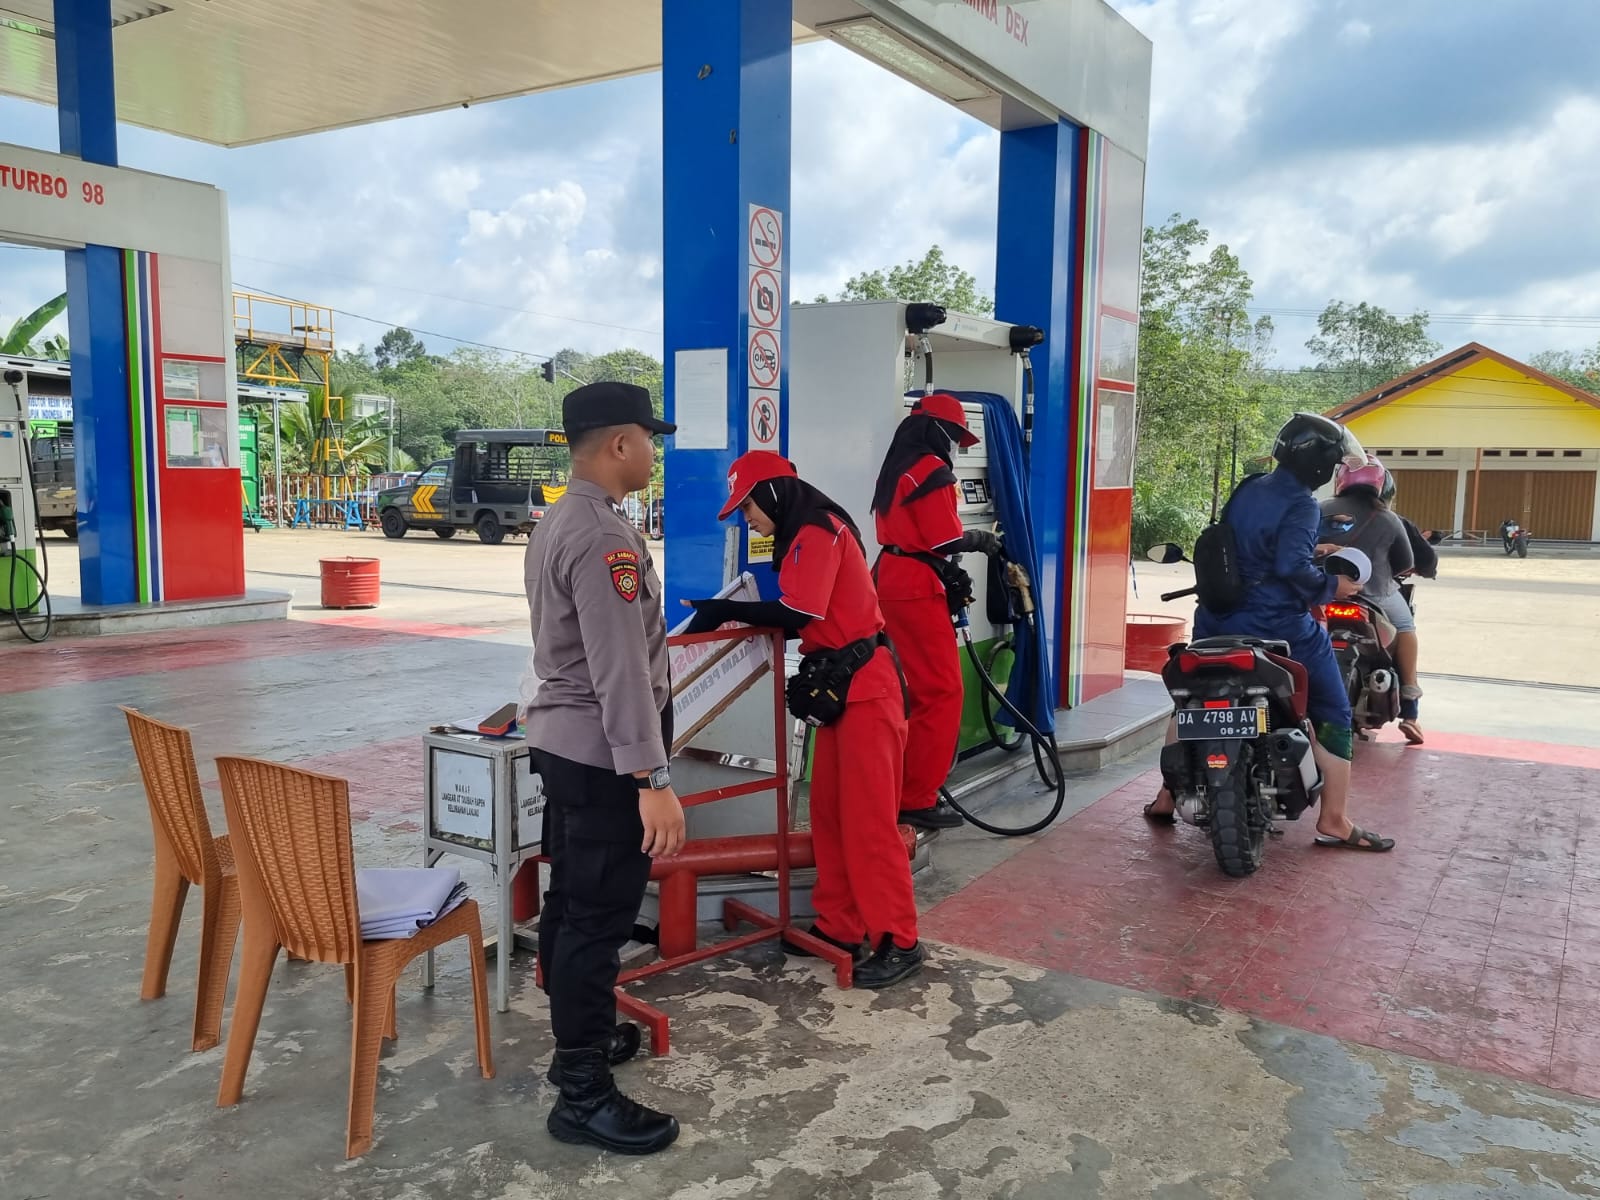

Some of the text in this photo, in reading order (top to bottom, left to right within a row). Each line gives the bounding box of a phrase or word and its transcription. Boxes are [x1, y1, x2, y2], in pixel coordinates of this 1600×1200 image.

[1005, 4, 1029, 47] DEX
[0, 164, 104, 206] TURBO 98
[1178, 709, 1256, 725] DA 4798 AV
